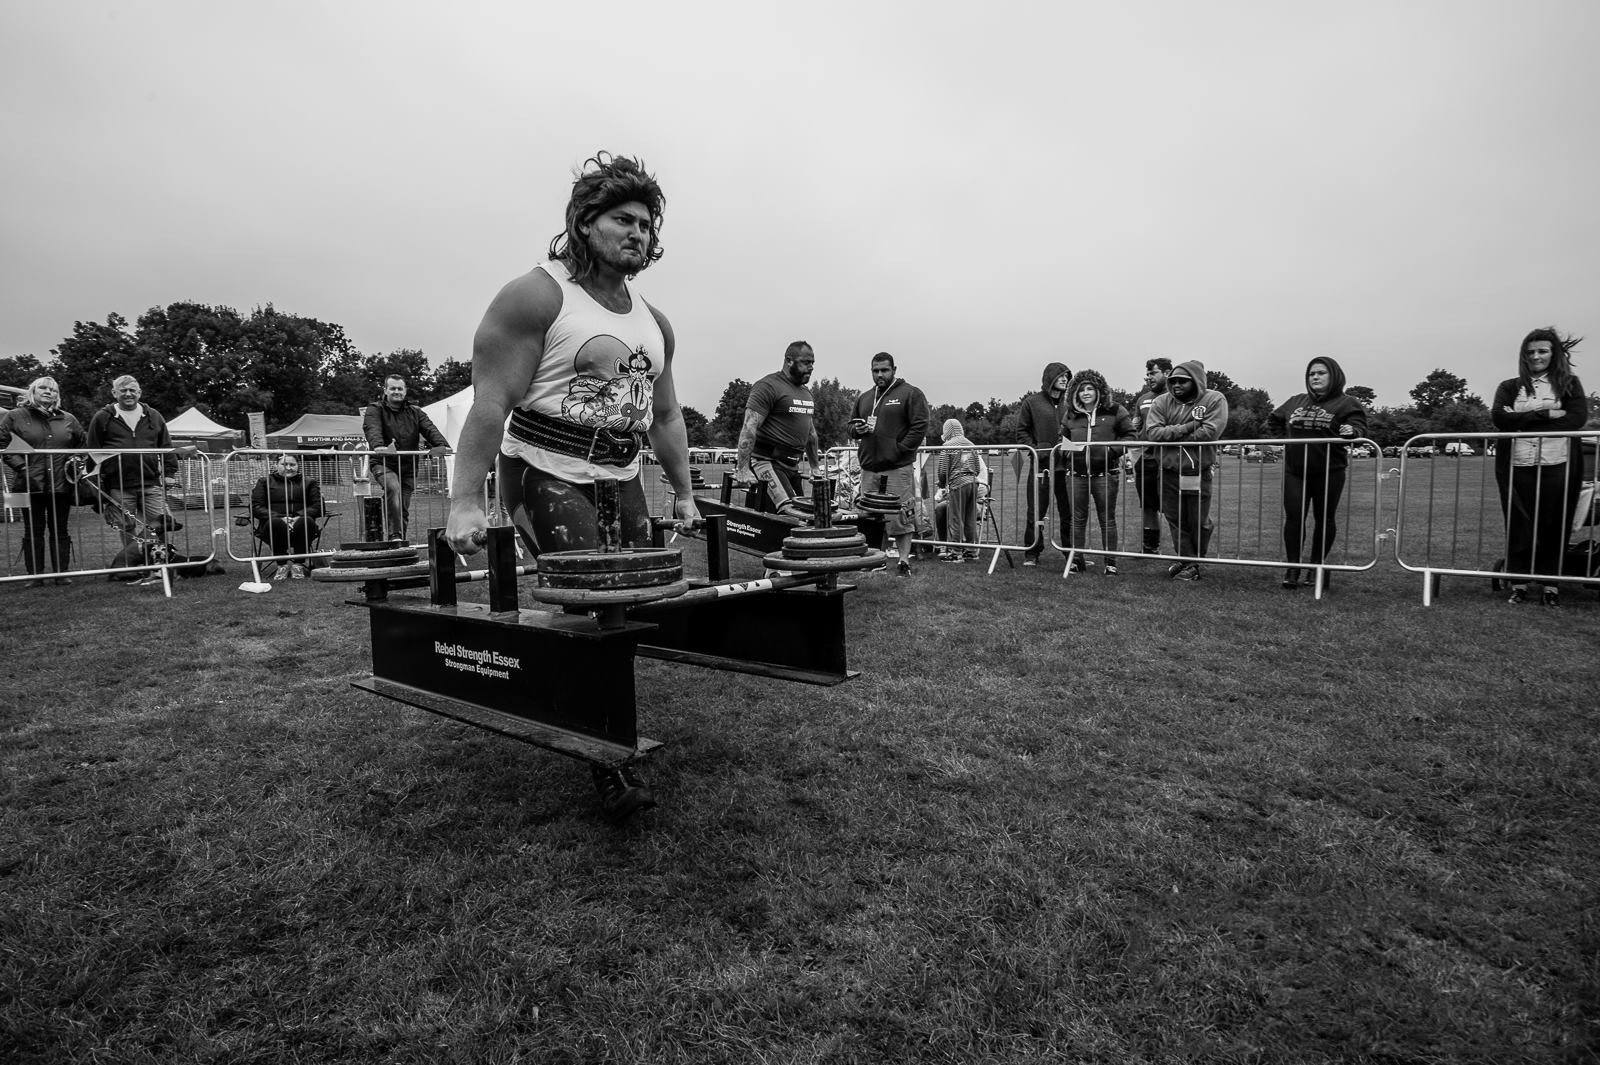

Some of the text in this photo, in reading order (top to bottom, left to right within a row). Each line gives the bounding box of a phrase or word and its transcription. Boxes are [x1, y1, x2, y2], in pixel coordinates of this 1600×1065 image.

[746, 524, 762, 535] Essex
[434, 640, 521, 669] Rebel Strength Essex
[444, 658, 510, 680] Strongman Equipment
